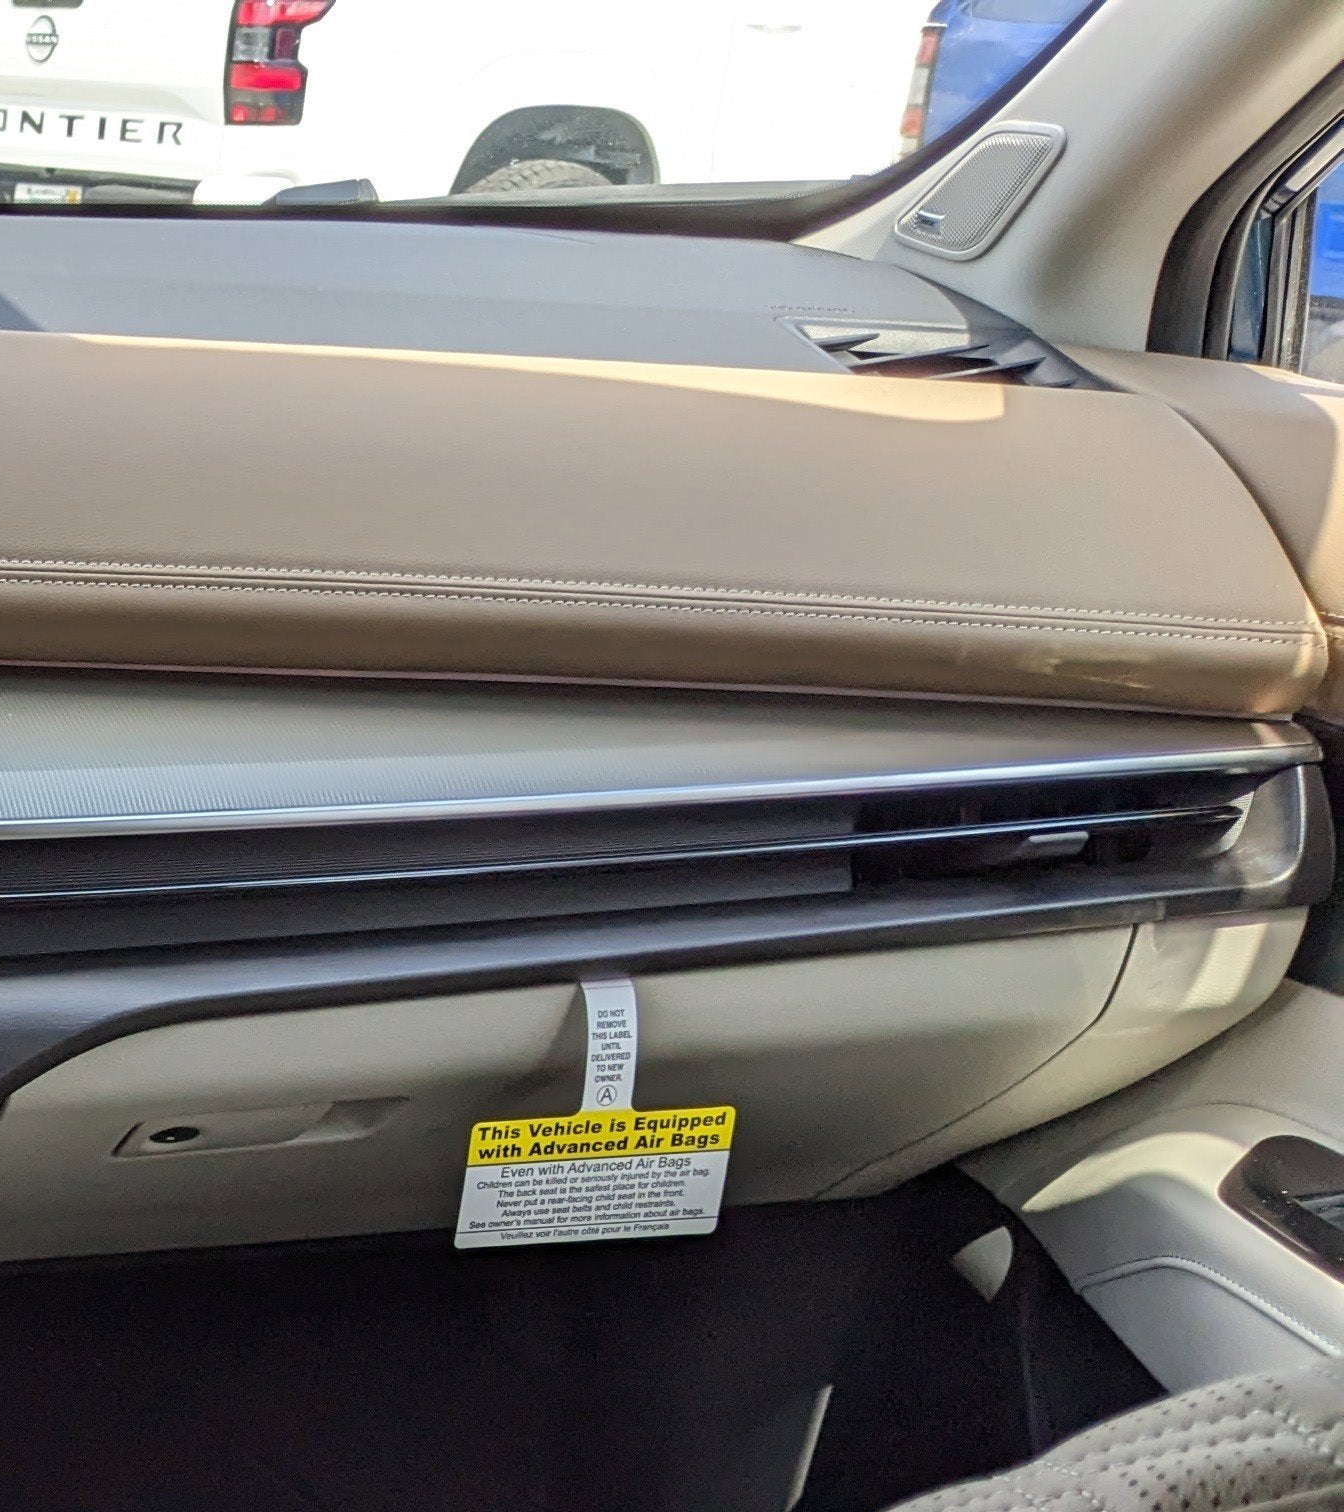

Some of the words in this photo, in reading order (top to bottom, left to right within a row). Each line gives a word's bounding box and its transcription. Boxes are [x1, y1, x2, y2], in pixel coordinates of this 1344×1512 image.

[597, 1010, 608, 1018] DO
[610, 1009, 625, 1017] NOT
[596, 1020, 627, 1029] REMOVE
[591, 1032, 607, 1040] THIS
[609, 1031, 632, 1039] LABEL
[601, 1042, 622, 1050] UNTIL
[591, 1052, 631, 1062] DELIVERED
[607, 1063, 624, 1071] NEW
[478, 1125, 521, 1141] This
[529, 1120, 602, 1138] Vehicle
[609, 1119, 626, 1132] is
[634, 1111, 727, 1133] Equipped
[478, 1144, 522, 1159] with
[528, 1136, 629, 1156] Advanced
[634, 1135, 665, 1149] Air
[670, 1133, 720, 1149] Bags
[500, 1166, 534, 1178] Even
[538, 1164, 564, 1176] with
[567, 1159, 632, 1174] Advanced
[635, 1158, 655, 1169] Air
[658, 1156, 691, 1170] Bags
[477, 1181, 512, 1190] Children
[532, 1178, 543, 1186] be
[545, 1177, 567, 1185] killed
[581, 1173, 618, 1183] seriously
[620, 1171, 649, 1180] injured
[652, 1170, 661, 1179] by
[499, 1190, 514, 1198] The
[516, 1188, 537, 1196] back
[539, 1187, 557, 1195] seat
[585, 1183, 611, 1192] safest
[613, 1181, 635, 1191] place
[637, 1181, 649, 1189] for
[496, 1200, 521, 1208] Never
[523, 1198, 537, 1207] put
[547, 1195, 593, 1204] rear-facing
[595, 1193, 615, 1201] child
[617, 1192, 636, 1200] seat
[647, 1190, 661, 1198] the
[501, 1209, 531, 1218] Always
[552, 1206, 570, 1214] seat
[594, 1203, 611, 1211] and
[613, 1202, 633, 1210] child
[469, 1221, 486, 1229] See
[523, 1217, 555, 1225] manual
[594, 1211, 641, 1220] information
[643, 1209, 667, 1218] about
[500, 1230, 533, 1240] Veuillez
[536, 1229, 551, 1237] voir
[582, 1226, 599, 1235] côté
[601, 1226, 621, 1234] pour
[633, 1223, 670, 1233] Français
